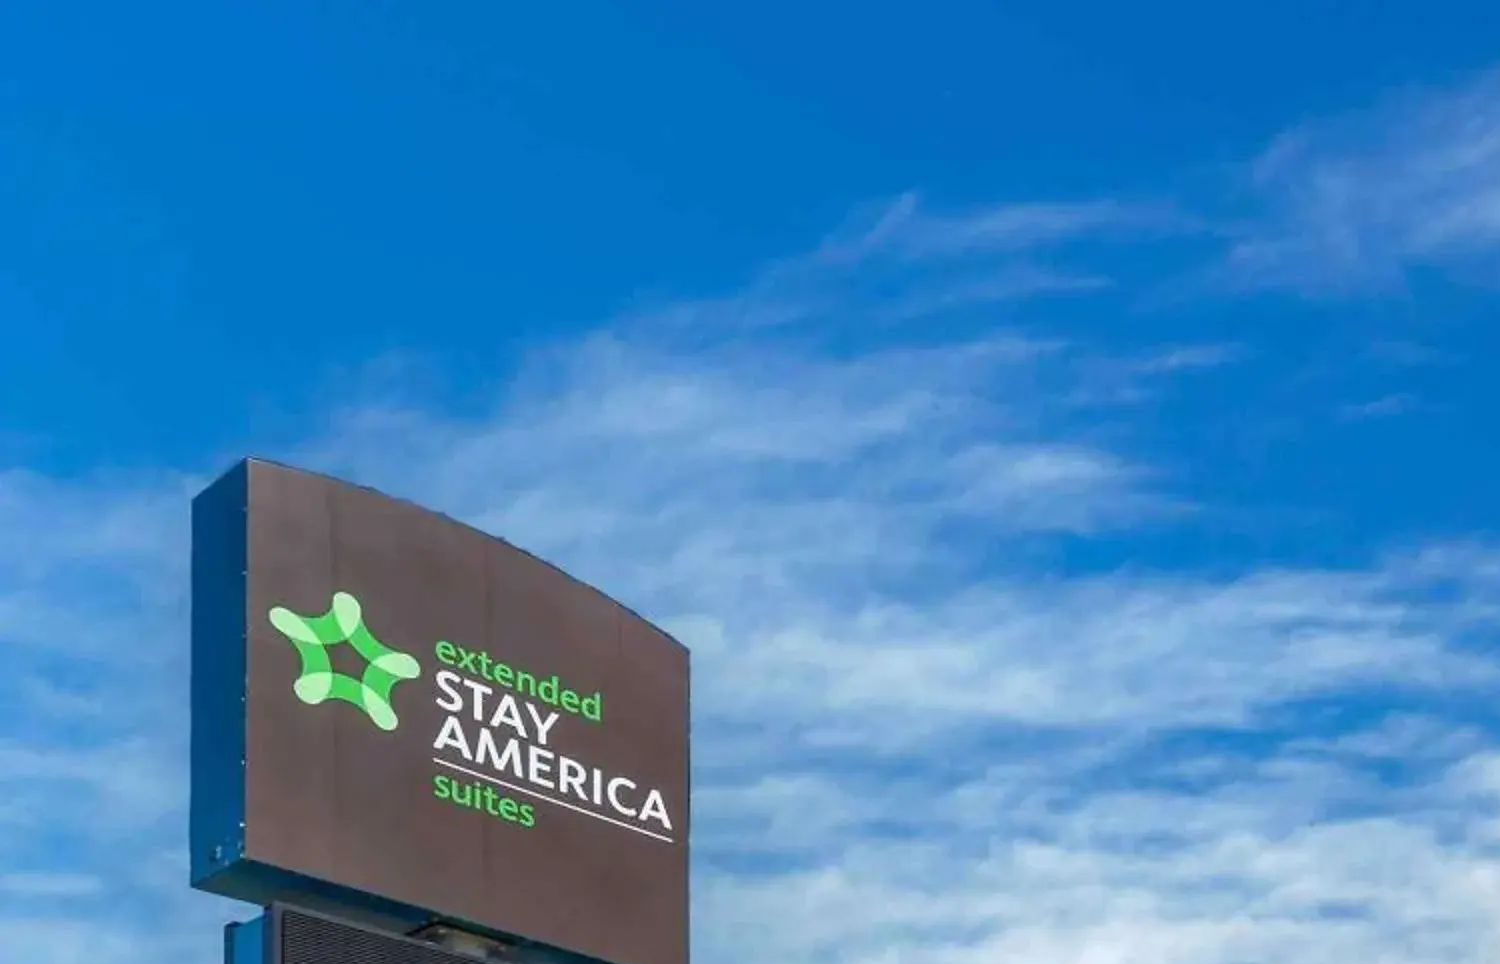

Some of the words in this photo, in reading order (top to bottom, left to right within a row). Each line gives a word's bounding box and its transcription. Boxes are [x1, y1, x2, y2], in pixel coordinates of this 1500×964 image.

[435, 640, 603, 722] extended
[435, 669, 561, 745] STAY
[433, 715, 673, 831] AMERICA
[434, 775, 535, 828] suites
